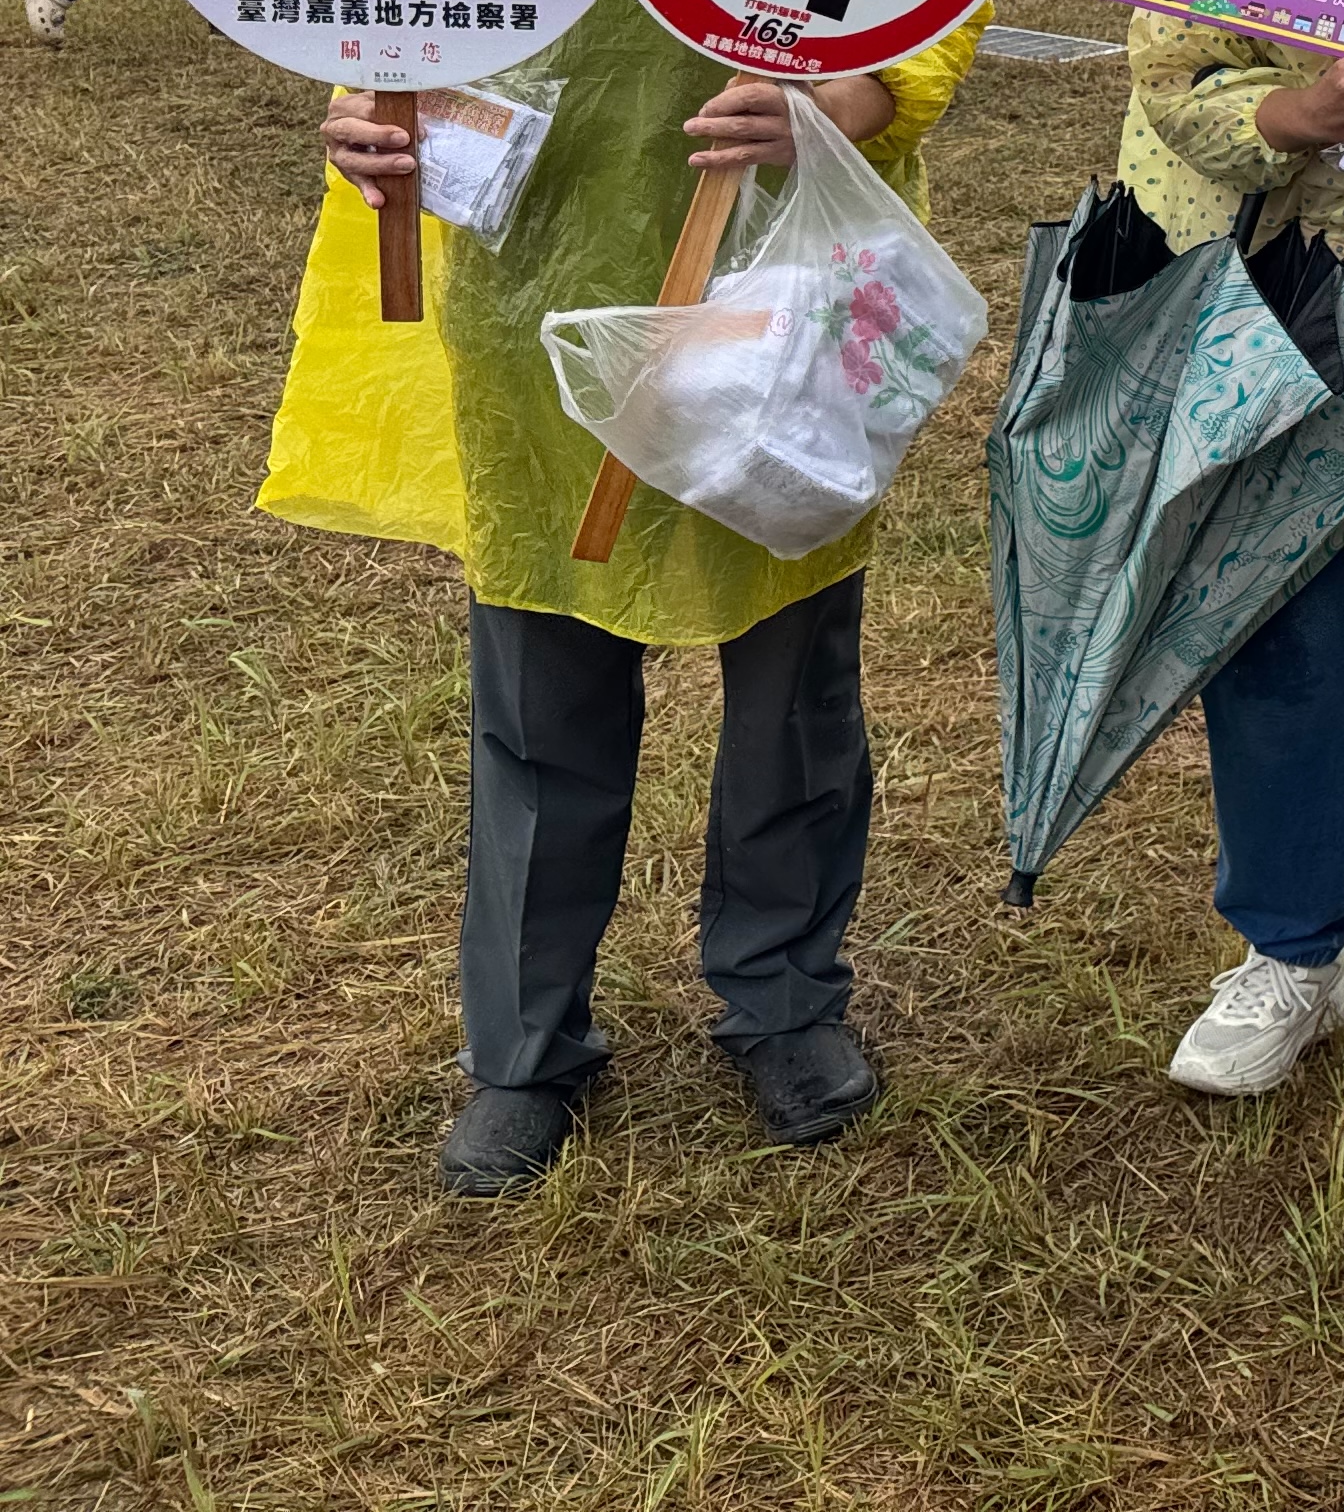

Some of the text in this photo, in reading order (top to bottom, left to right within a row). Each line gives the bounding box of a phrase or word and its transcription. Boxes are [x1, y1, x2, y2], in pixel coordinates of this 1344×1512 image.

[740, 13, 804, 49] 165
[341, 40, 442, 64] 關心您
[703, 33, 822, 73] 嘉義地檢署關心您
